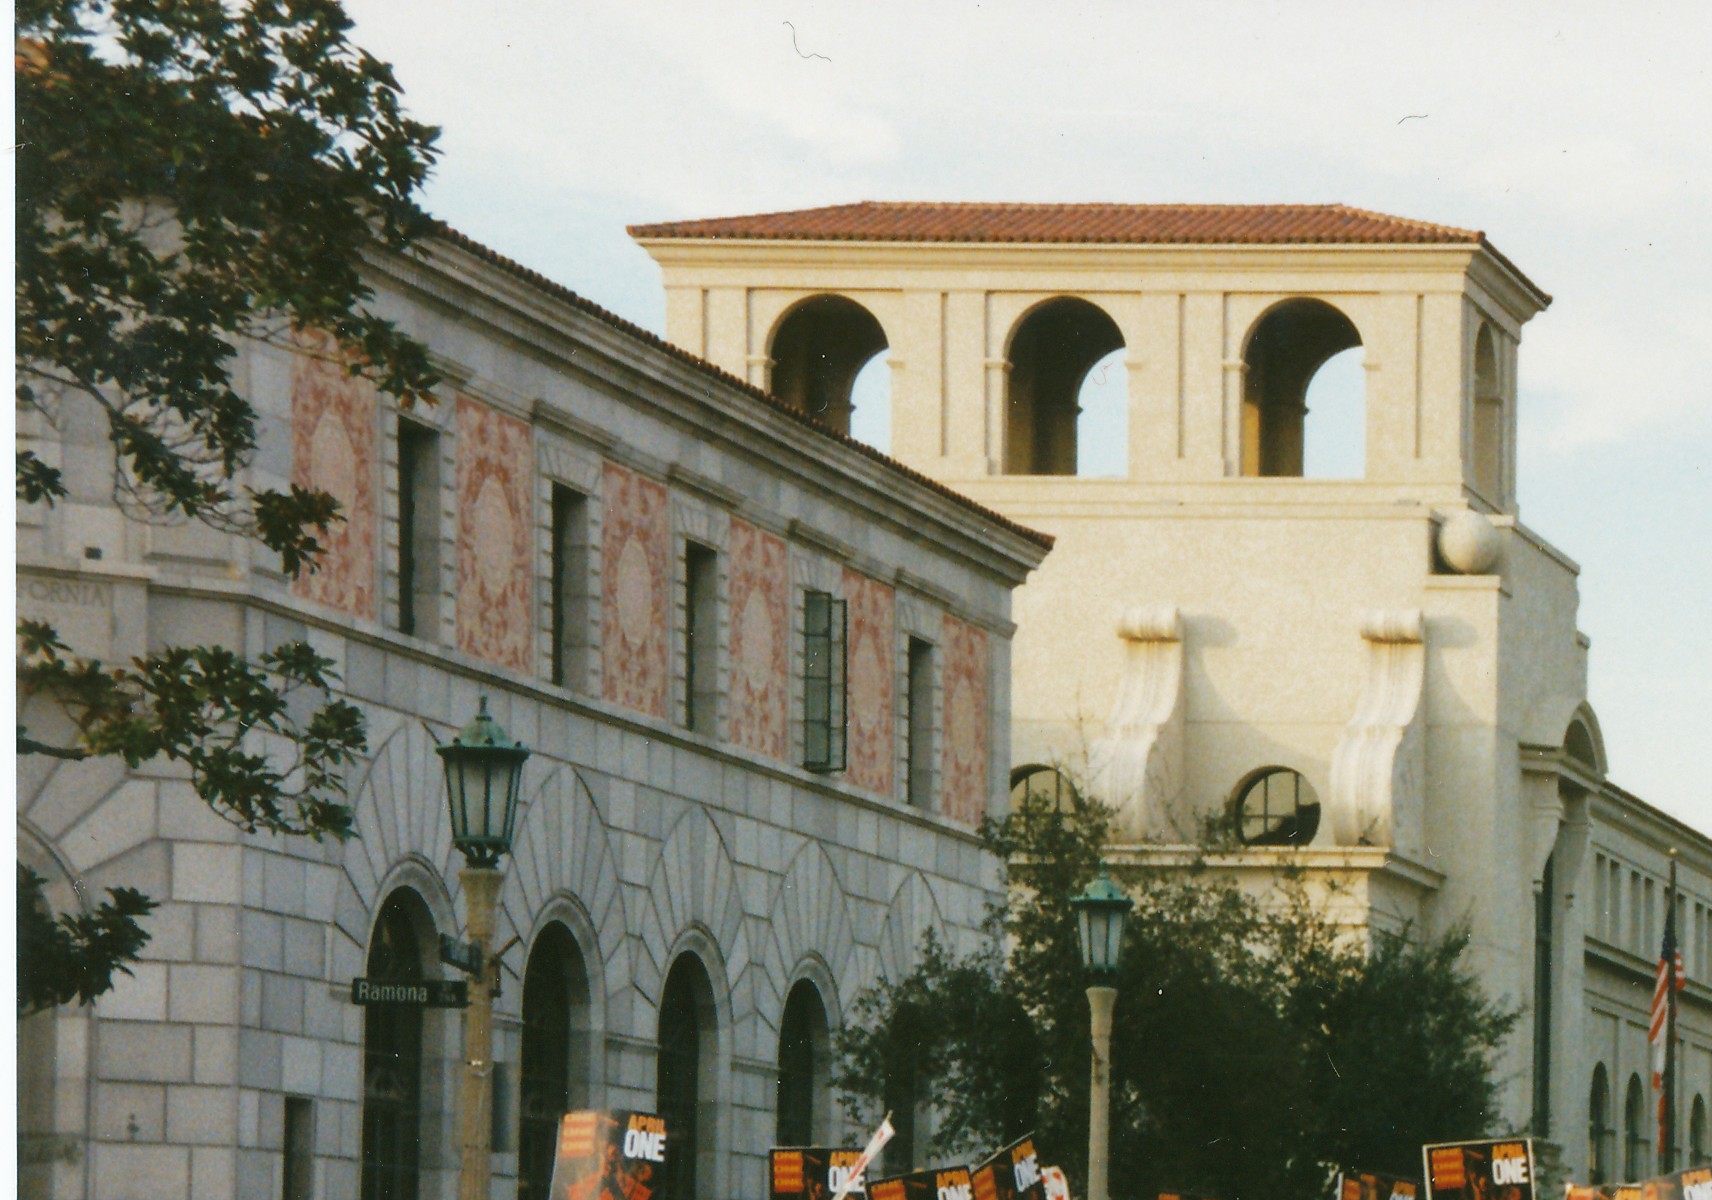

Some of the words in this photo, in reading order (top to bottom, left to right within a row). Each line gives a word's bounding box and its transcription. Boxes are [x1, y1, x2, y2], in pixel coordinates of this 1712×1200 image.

[18, 579, 106, 607] ORNIA
[358, 981, 428, 1003] Ramona
[624, 1129, 667, 1163] ONE
[828, 1165, 866, 1193] ONE
[1013, 1153, 1042, 1194] ONE
[1492, 1157, 1529, 1186] ONE
